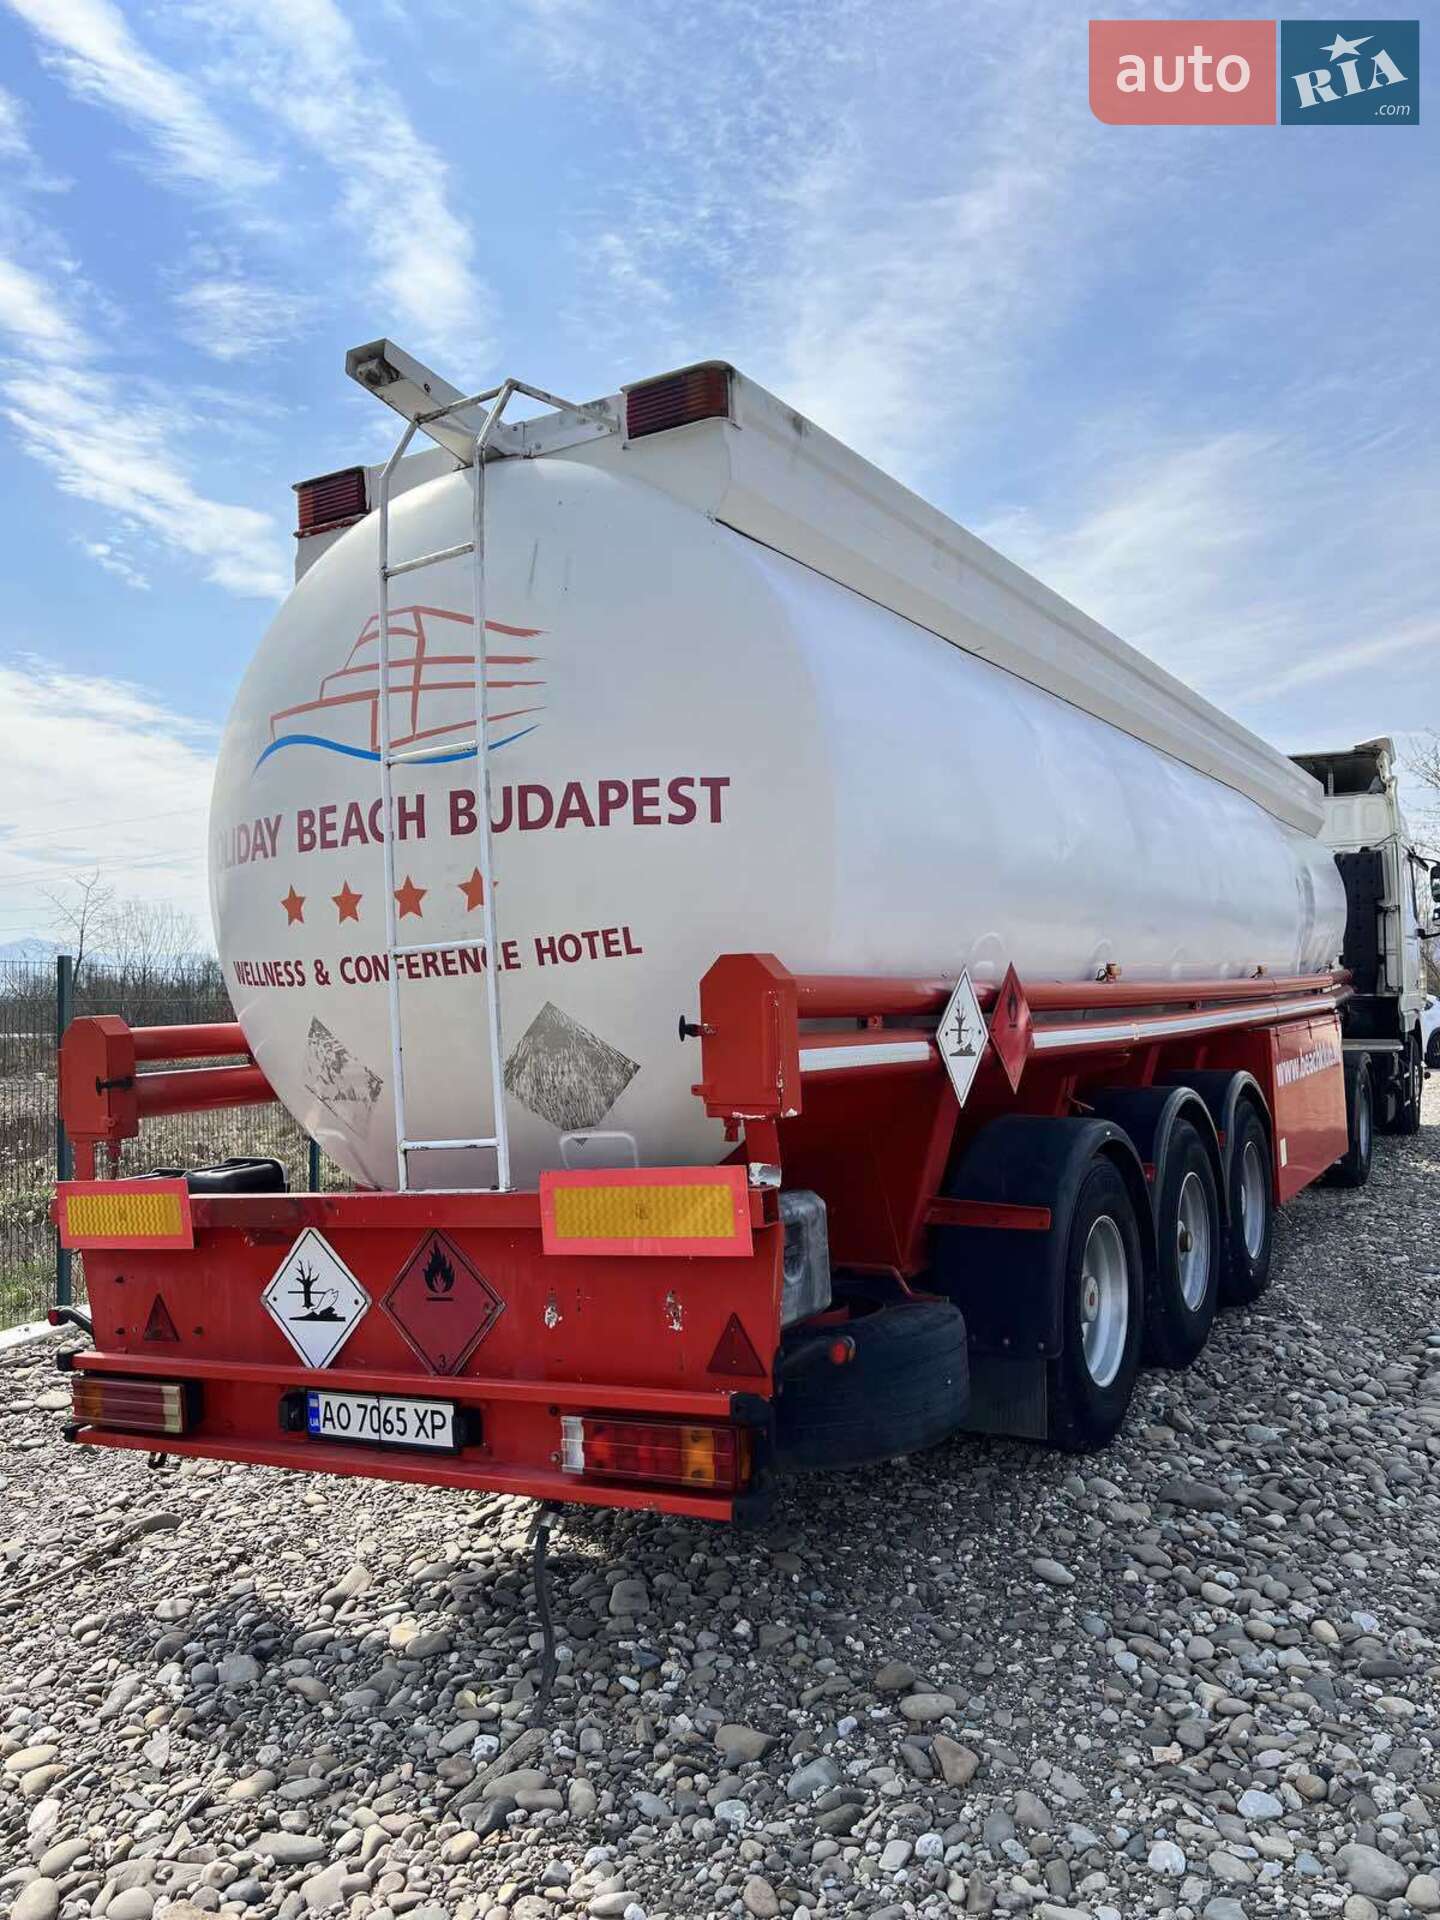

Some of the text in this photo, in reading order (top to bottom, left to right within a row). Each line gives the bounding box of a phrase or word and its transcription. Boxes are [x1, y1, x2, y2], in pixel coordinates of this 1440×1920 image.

[296, 793, 426, 853] BEACH
[449, 776, 731, 836] BUDAPEST
[233, 959, 306, 987] WELLNESS
[313, 958, 331, 986] &
[534, 926, 643, 966] HOTEL
[321, 1400, 447, 1441] AO 7065 XP
